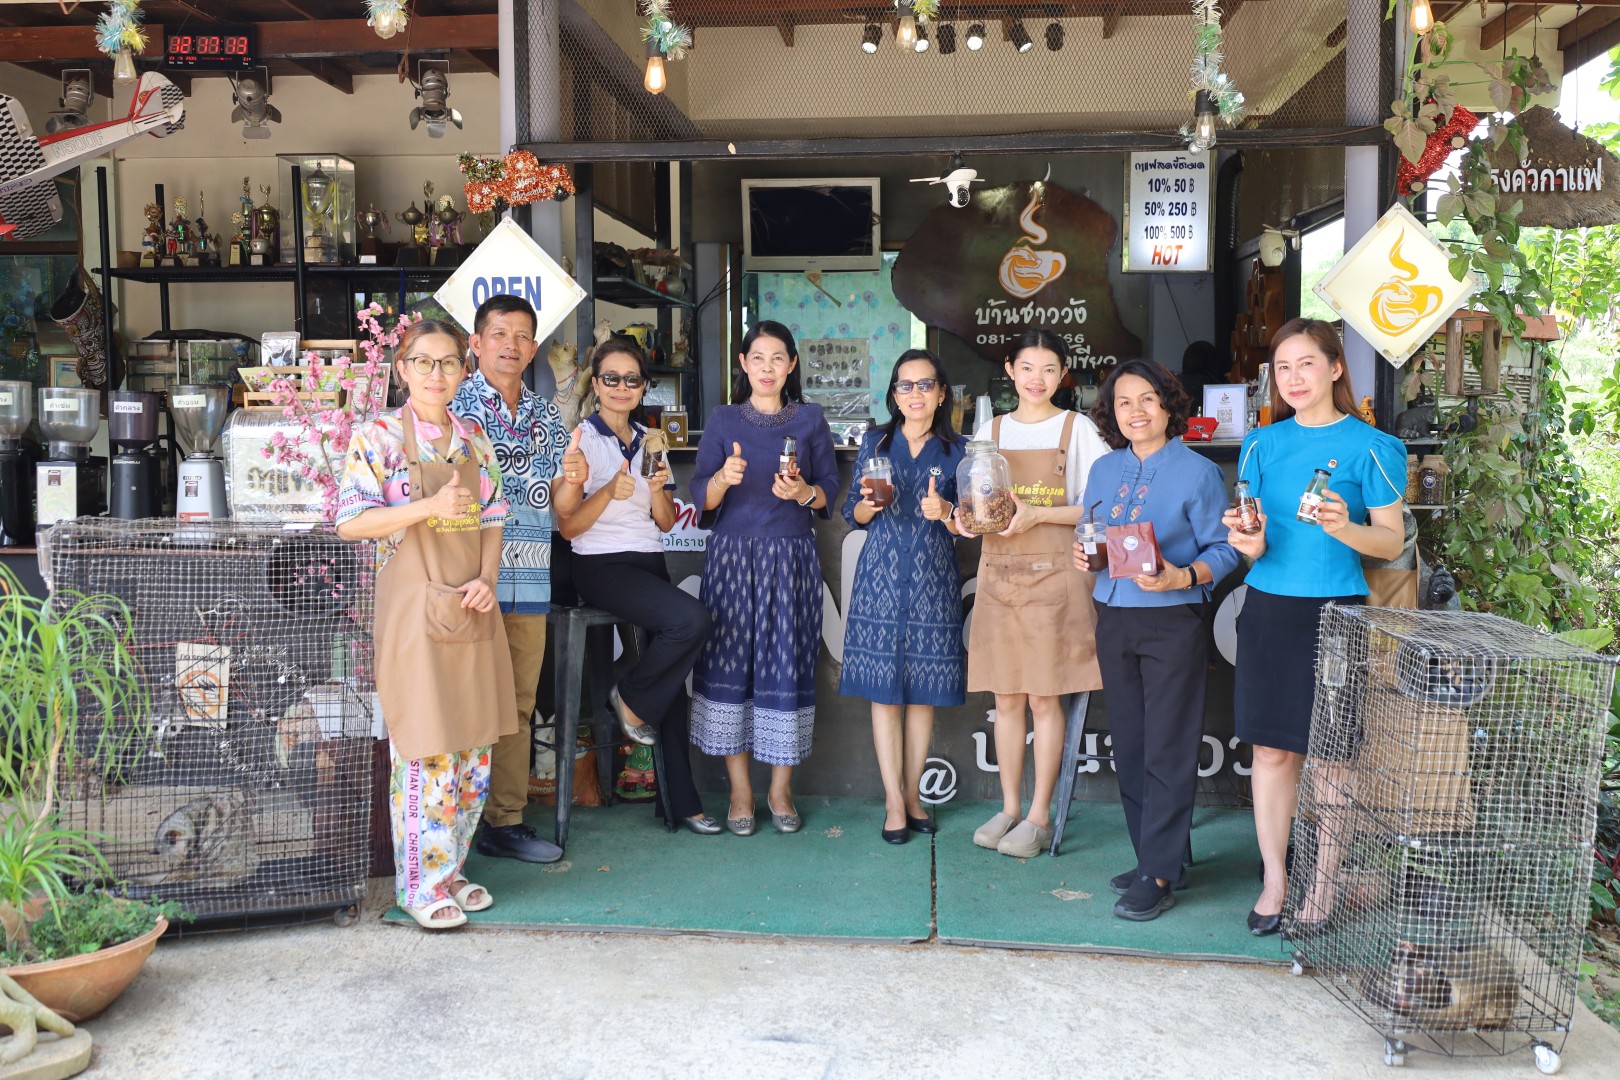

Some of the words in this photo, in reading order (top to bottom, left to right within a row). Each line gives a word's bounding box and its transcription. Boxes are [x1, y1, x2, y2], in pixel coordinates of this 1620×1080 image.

[52, 132, 104, 158] N500F
[1147, 178, 1171, 194] 10%
[1174, 178, 1187, 193] 50
[1144, 201, 1165, 216] 50%
[1168, 201, 1188, 216] 250
[1144, 225, 1168, 239] 100%
[1170, 225, 1186, 239] 500
[1151, 245, 1183, 265] HOT
[974, 297, 1088, 326] บ้านชาววัง
[661, 533, 704, 547] วโคราช
[408, 758, 421, 792] STIAN
[408, 794, 419, 819] DIOR
[408, 832, 420, 881] CHRISTIAN
